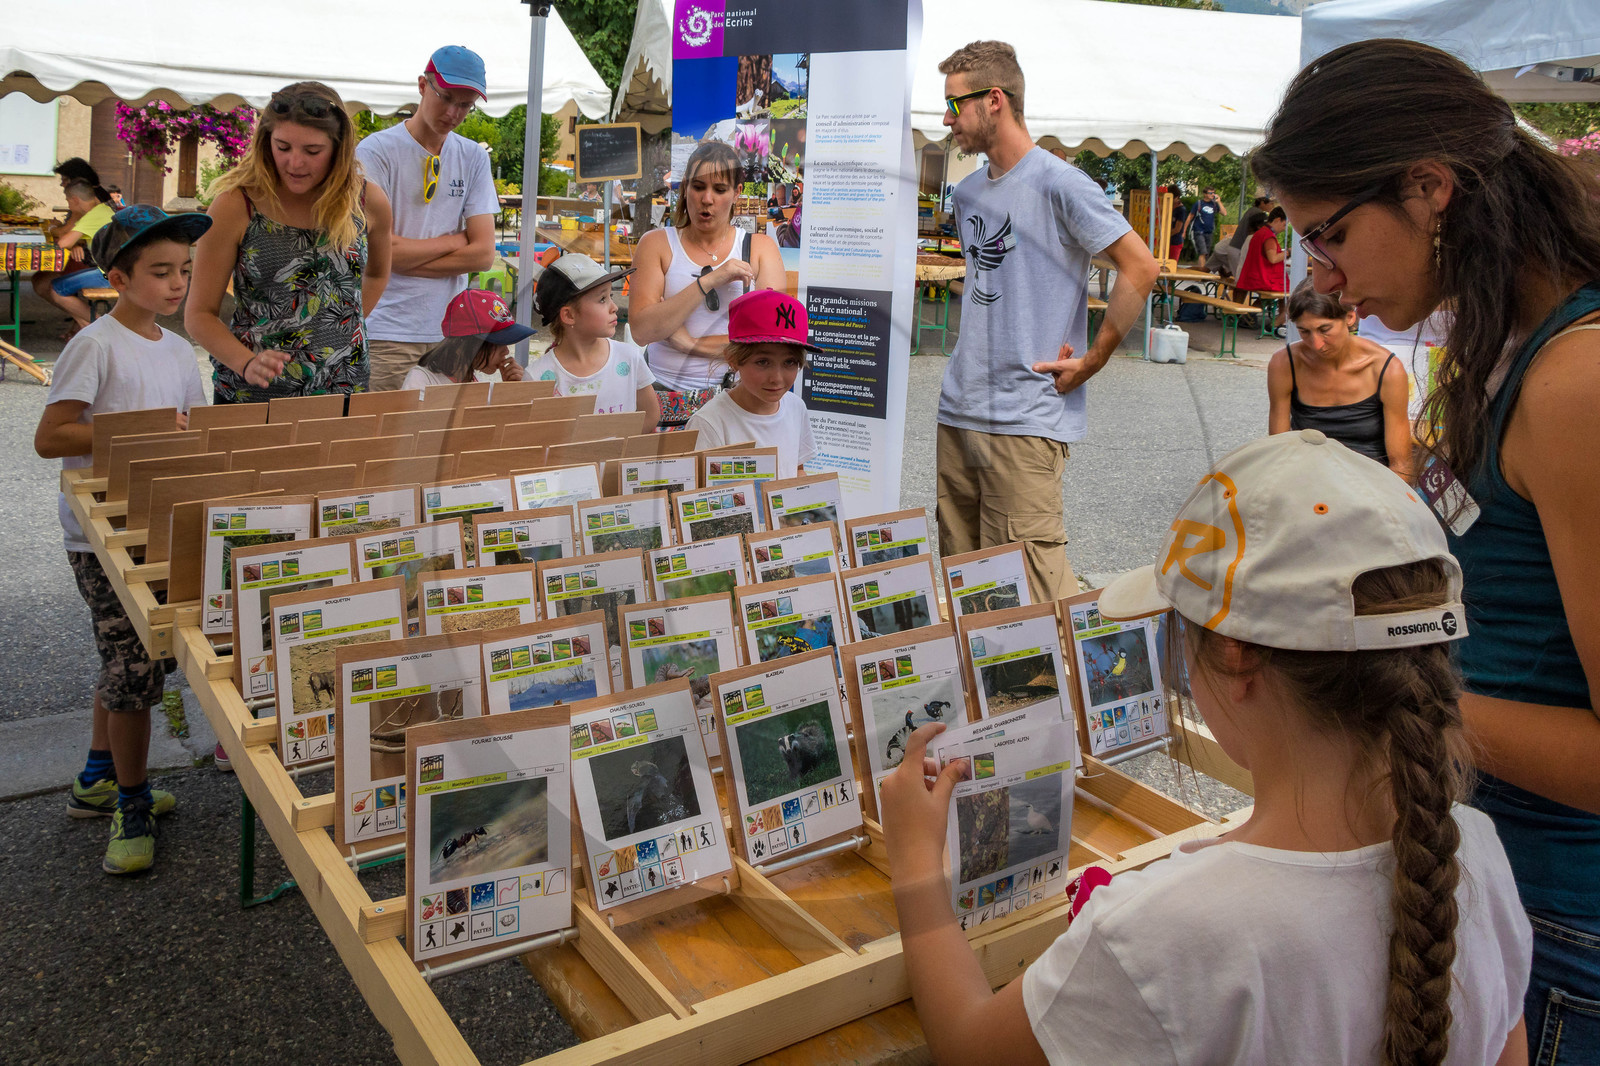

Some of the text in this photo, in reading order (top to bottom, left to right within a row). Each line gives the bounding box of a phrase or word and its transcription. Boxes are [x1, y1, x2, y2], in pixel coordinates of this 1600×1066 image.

[726, 8, 757, 16] national
[726, 18, 752, 27] Ecrins
[823, 297, 848, 305] grandes
[850, 298, 877, 307] missions
[836, 307, 862, 315] national
[776, 303, 796, 329] NY
[845, 338, 876, 347] patrimoines.
[812, 380, 862, 390] L'accompagnement
[812, 386, 852, 395] développement
[1162, 519, 1226, 591] R
[1388, 621, 1441, 636] ROSSIGNOL
[766, 670, 784, 678] BLAIREAU
[610, 701, 645, 713] CHAUVE-SOURIS
[972, 714, 1026, 735] MESANGE CHARBONNIERE
[994, 738, 1016, 747] LAGOPEDE
